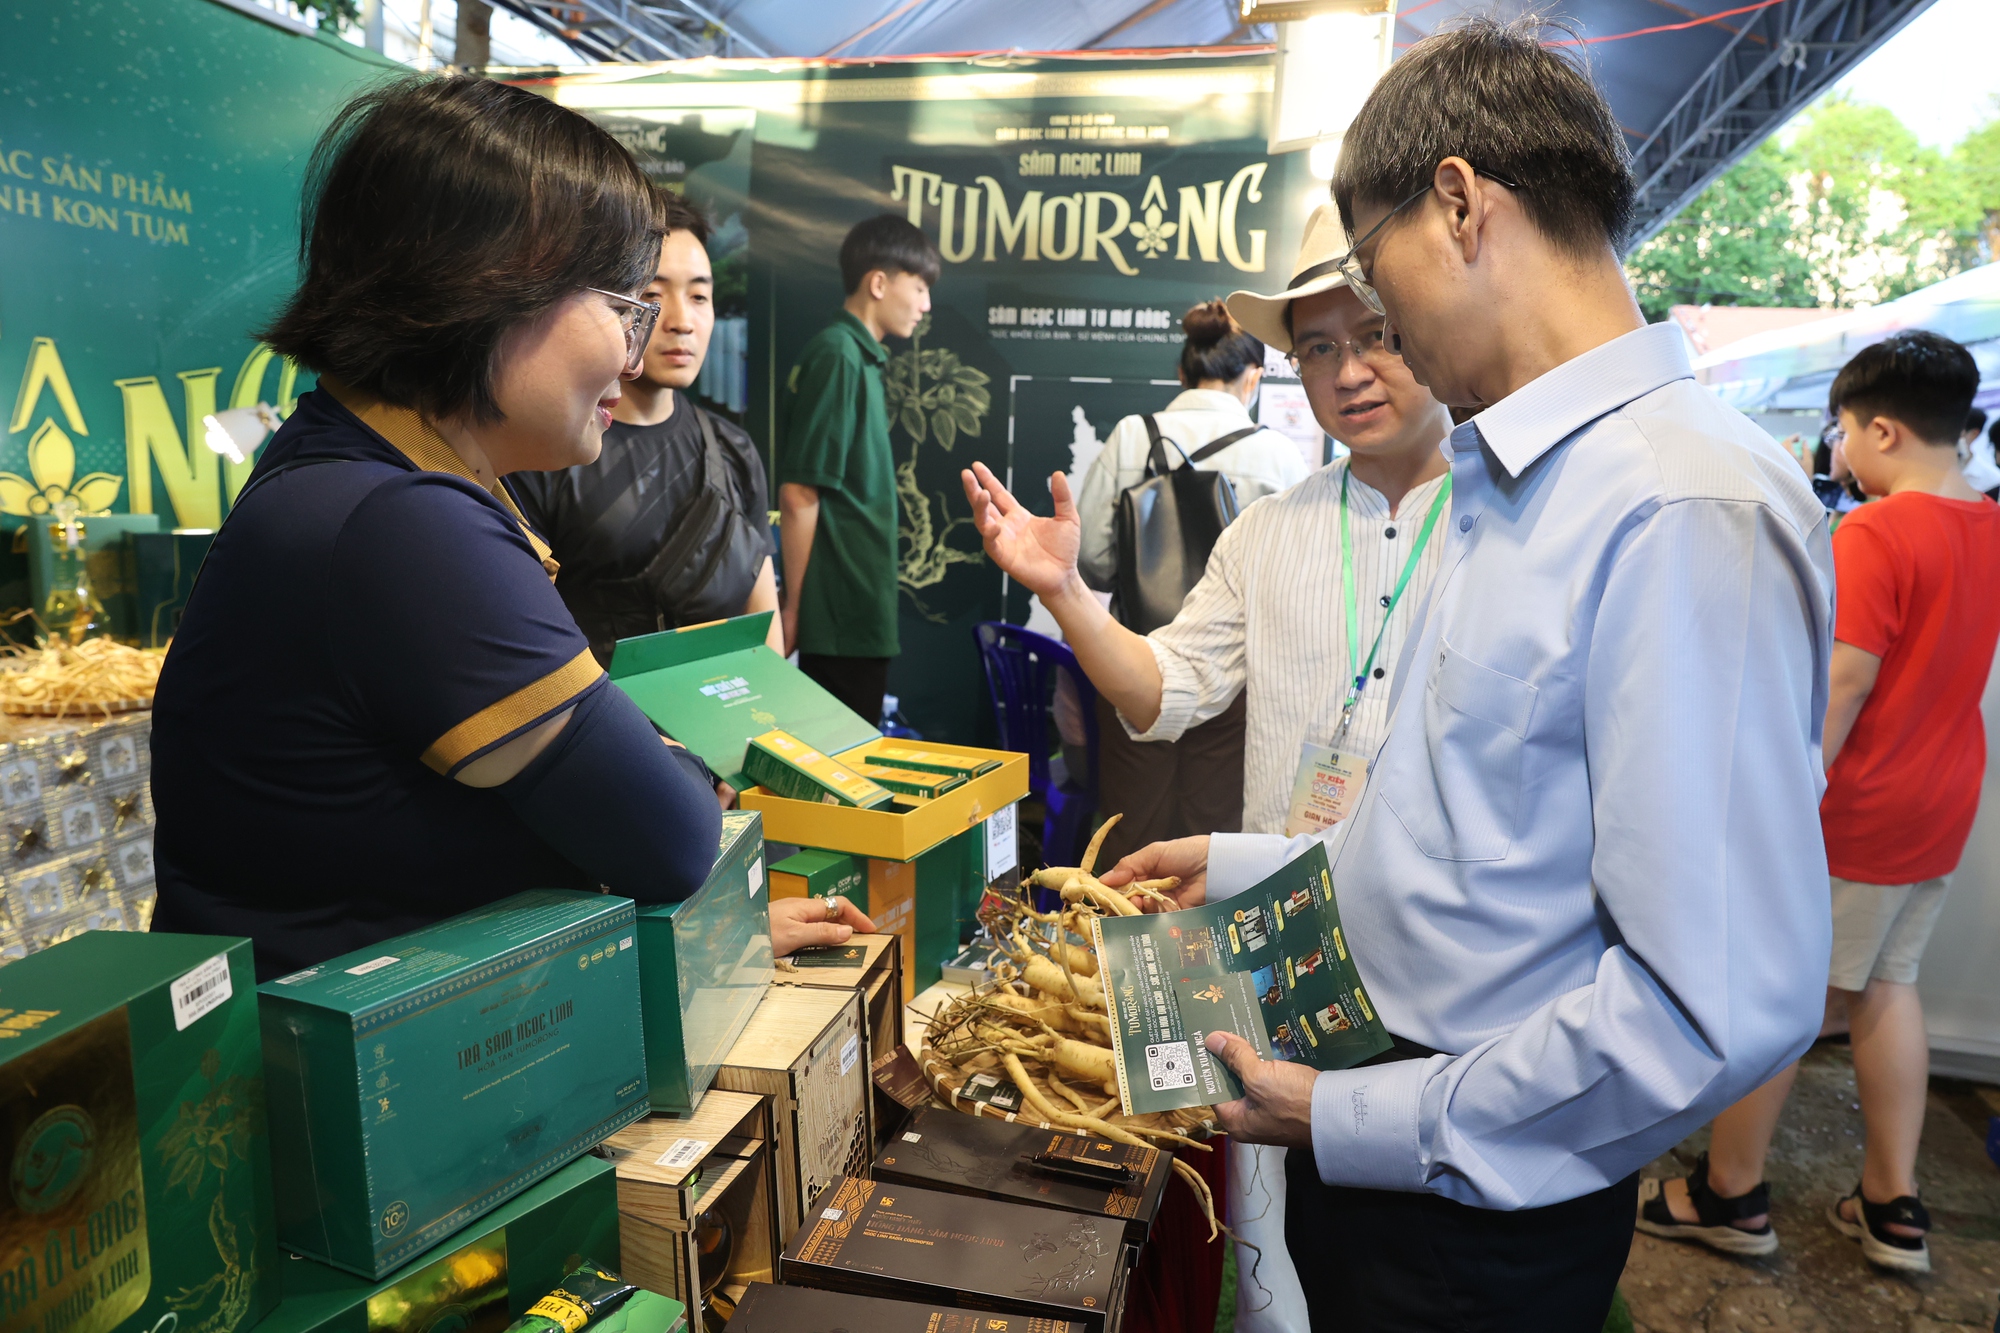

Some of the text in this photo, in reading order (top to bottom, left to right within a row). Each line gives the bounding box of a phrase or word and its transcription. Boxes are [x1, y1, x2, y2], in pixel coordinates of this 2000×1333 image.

[1019, 150, 1142, 179] SÂM NGỌC LINH
[42, 154, 102, 193] SẢN
[111, 173, 194, 215] PHẨM
[52, 196, 118, 232] KON
[124, 209, 190, 246] TUM
[988, 304, 1017, 325] SÂM
[1057, 308, 1087, 327] LINH
[1090, 308, 1108, 327] TU
[457, 1041, 481, 1071] TRÀ
[485, 1029, 513, 1057] SÂM
[517, 1013, 546, 1042] NGỌC
[550, 999, 573, 1026] LINH
[1190, 1030, 1204, 1046] NGÀ
[1195, 1047, 1209, 1067] XUÂN
[44, 1227, 63, 1287] Ô
[70, 1188, 138, 1271] LONG
